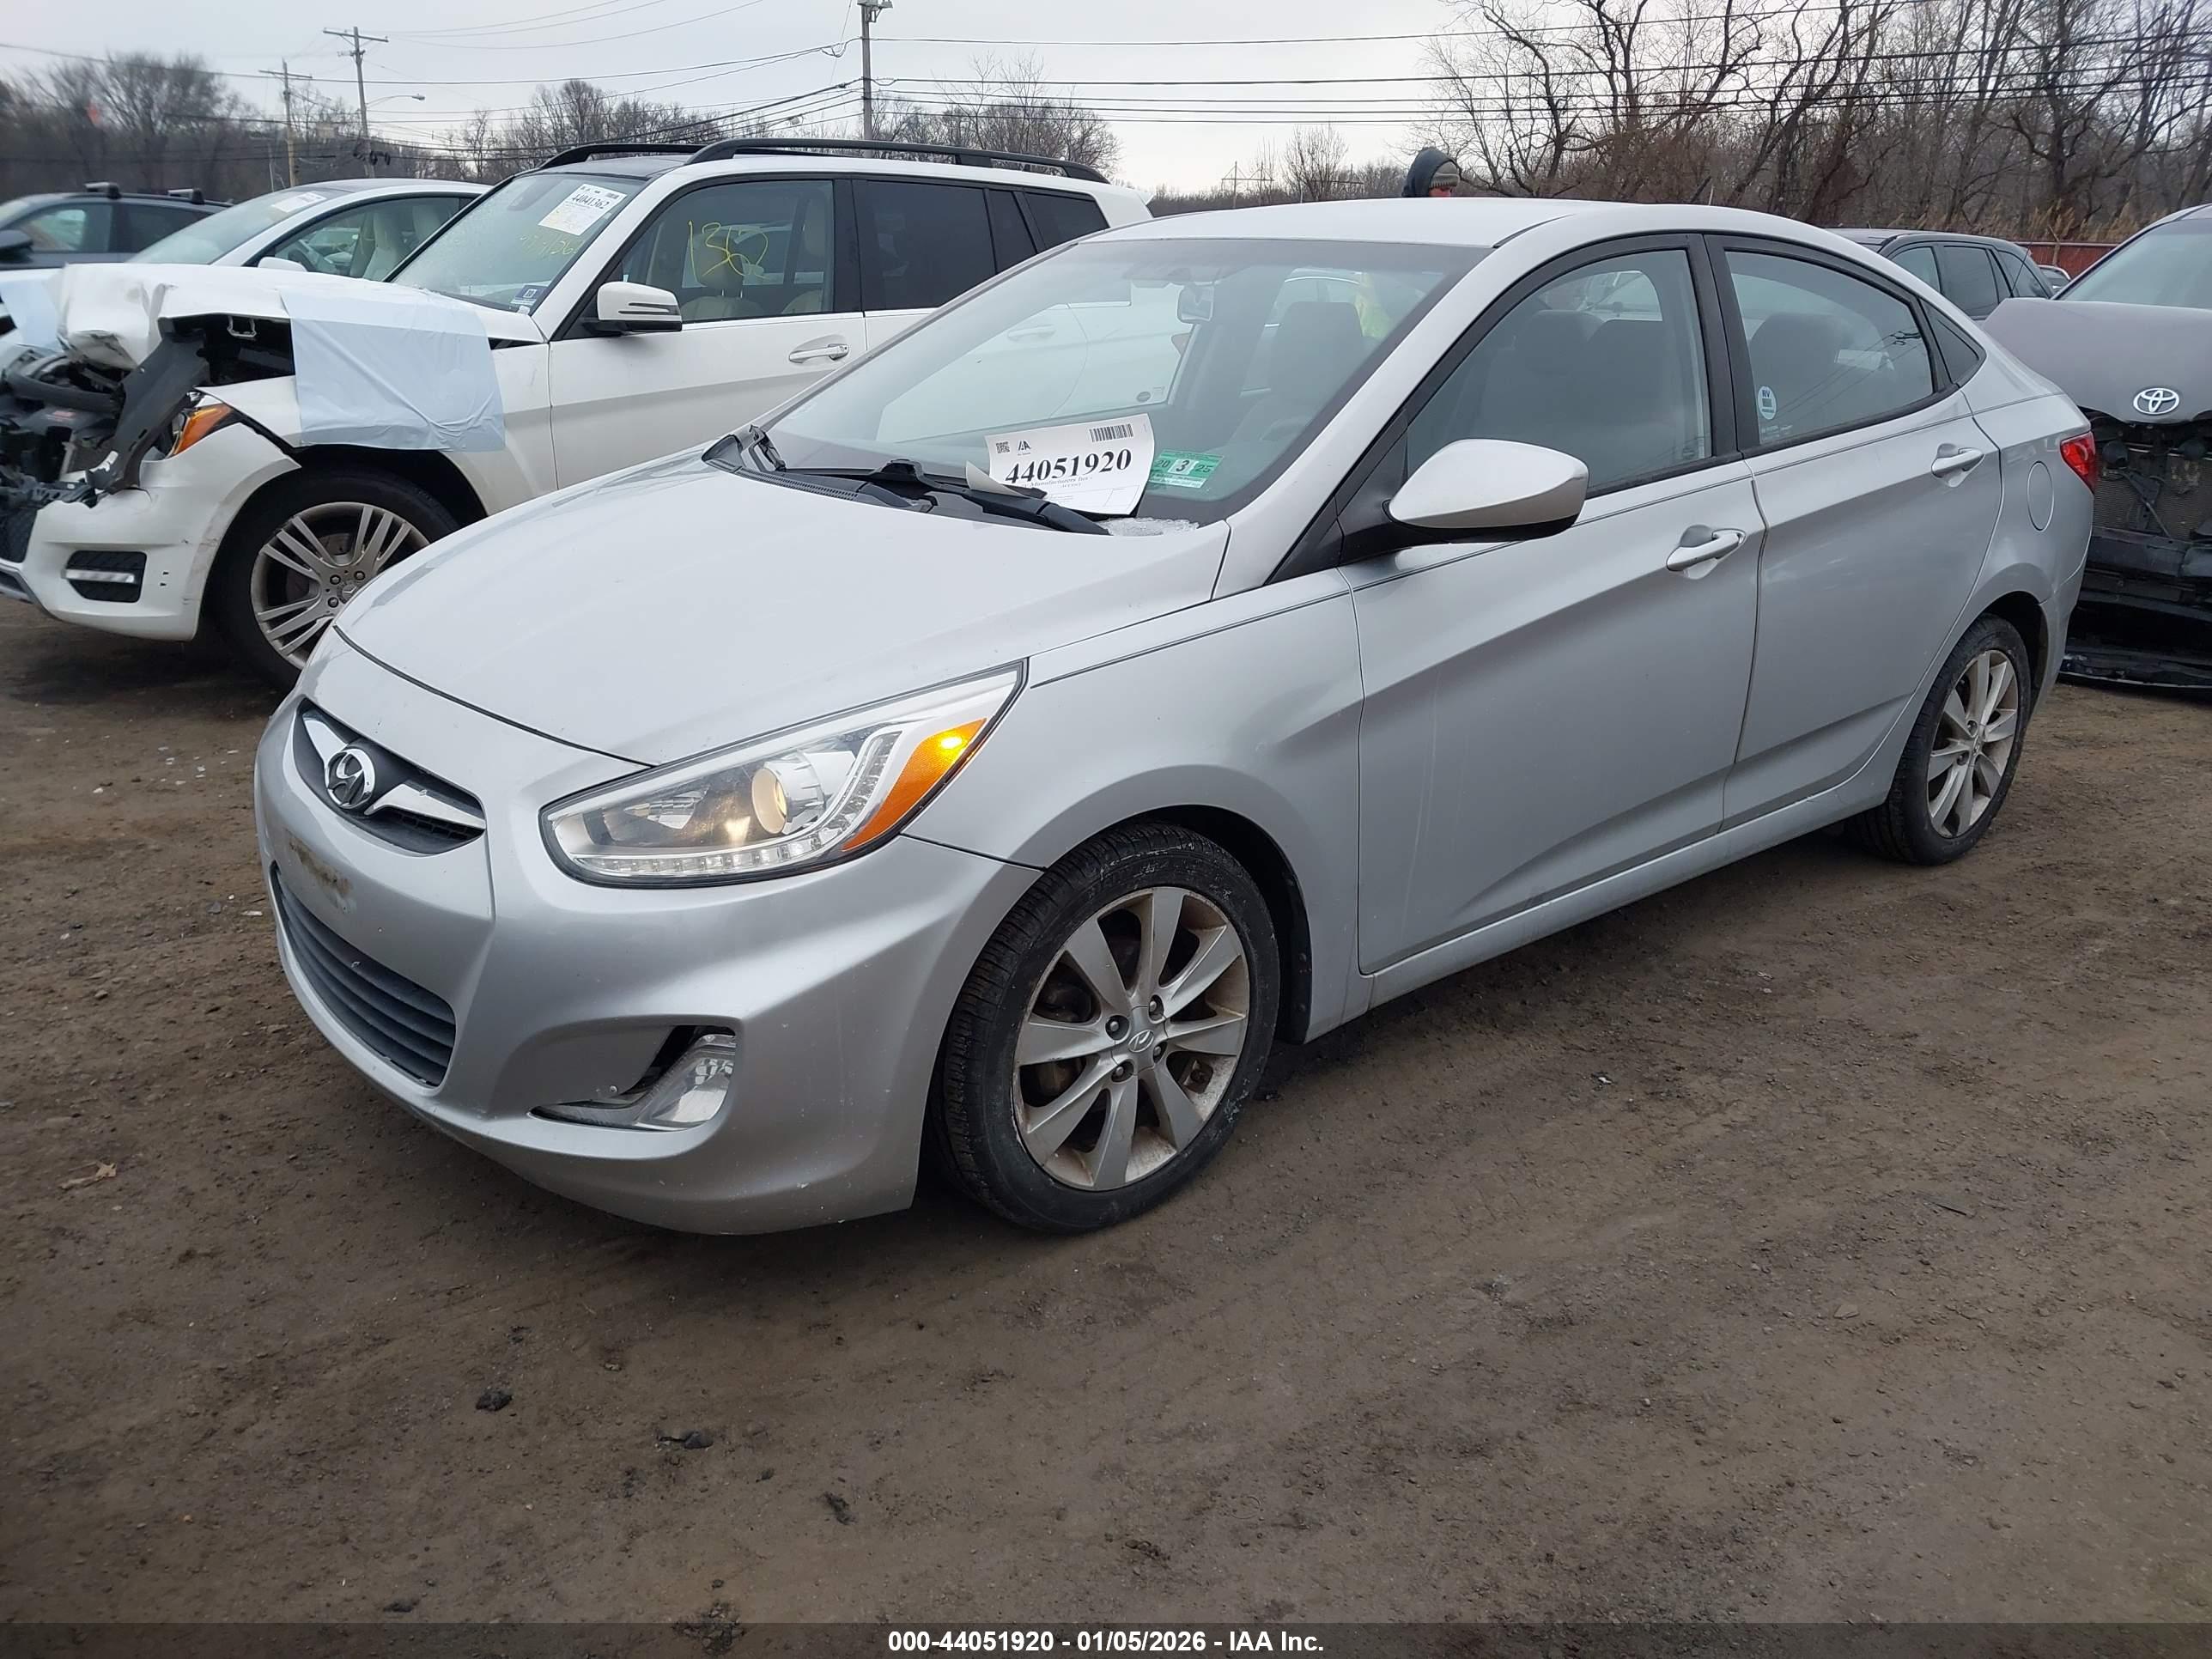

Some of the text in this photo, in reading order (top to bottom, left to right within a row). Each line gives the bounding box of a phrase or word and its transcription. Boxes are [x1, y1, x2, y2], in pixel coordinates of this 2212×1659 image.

[1005, 448, 1132, 483] 44051920
[1176, 459, 1189, 472] 3
[1194, 465, 1213, 473] 25
